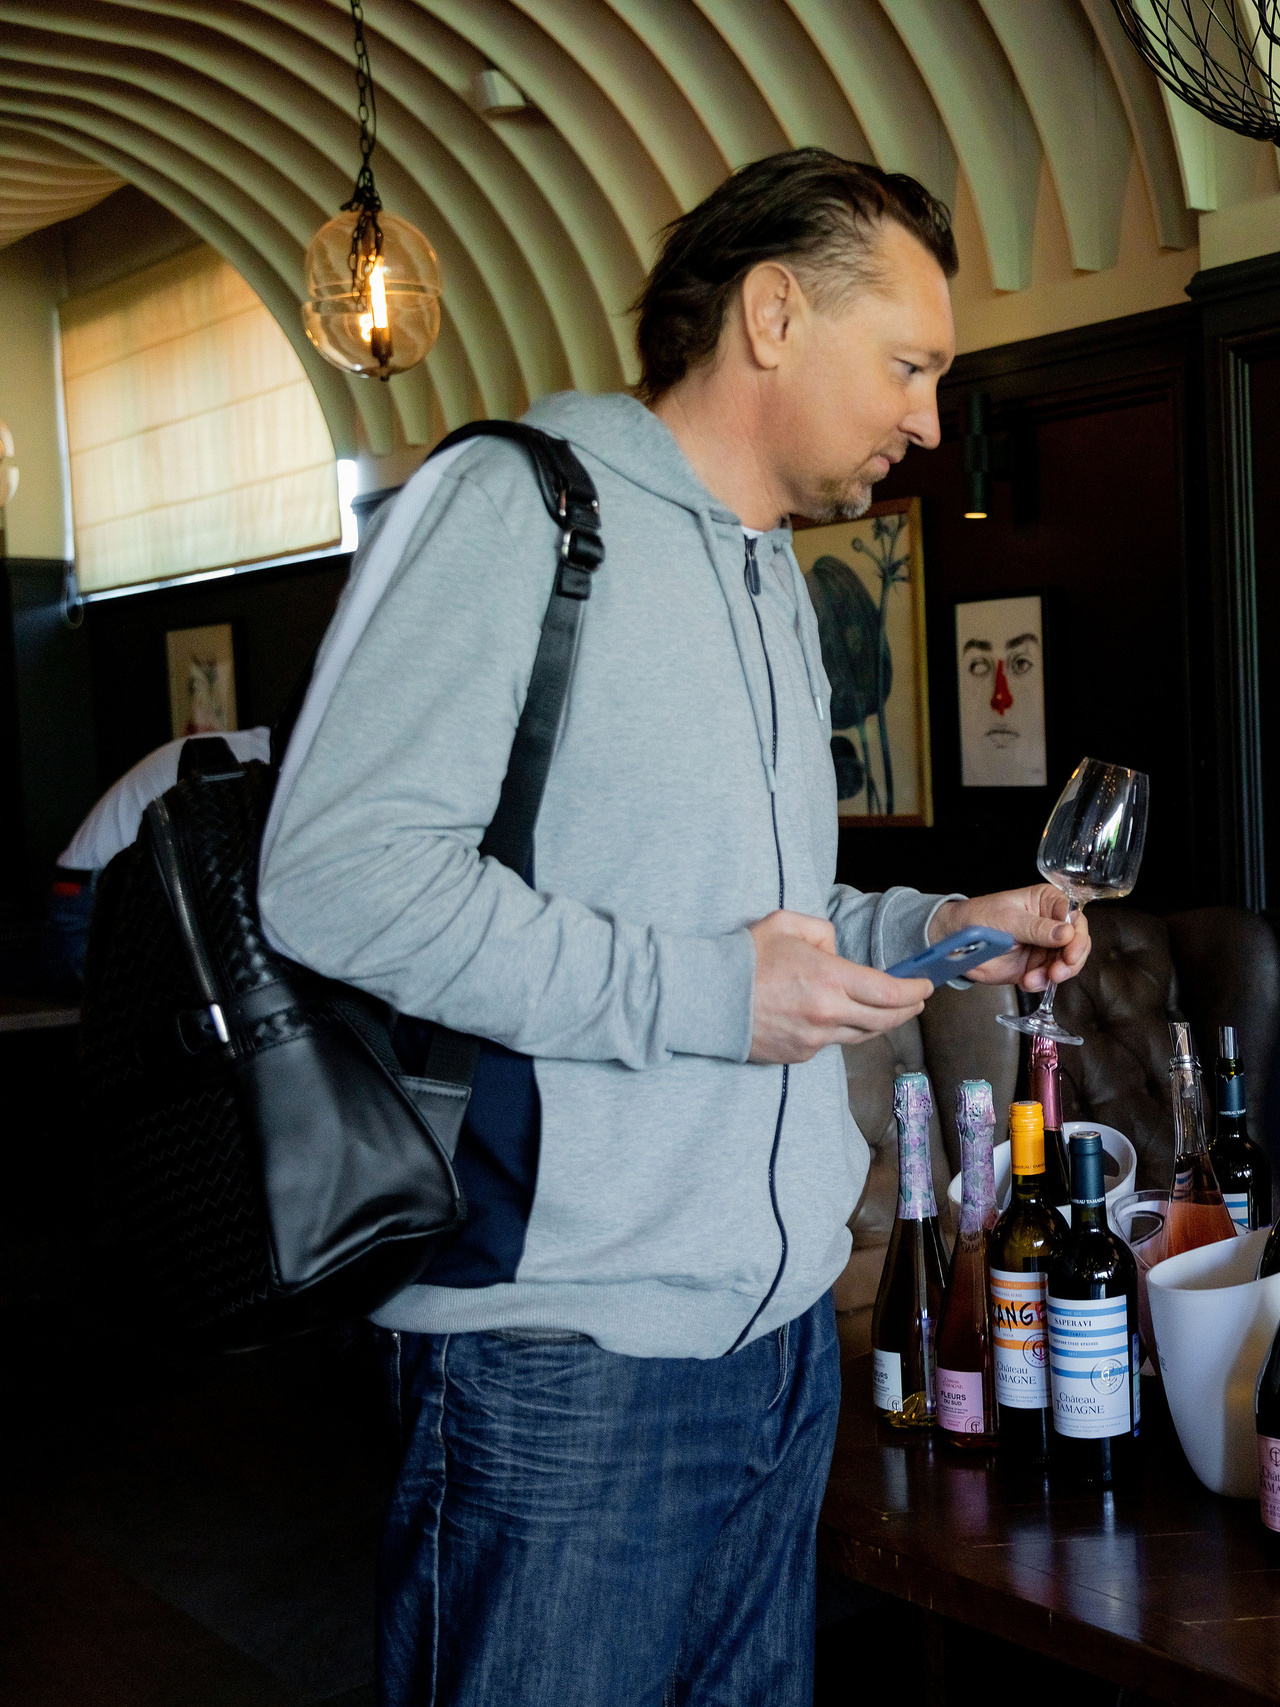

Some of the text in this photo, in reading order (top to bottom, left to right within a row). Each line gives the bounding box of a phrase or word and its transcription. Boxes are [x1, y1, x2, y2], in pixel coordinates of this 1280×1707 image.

[1086, 1196, 1105, 1204] TAMAGN
[992, 1300, 1047, 1331] RANGE
[1054, 1317, 1092, 1327] SAPERAVI
[996, 1360, 1028, 1375] Château
[941, 1390, 967, 1401] FLEURS
[1059, 1391, 1096, 1404] Château
[1055, 1398, 1105, 1415] TAMAGNE
